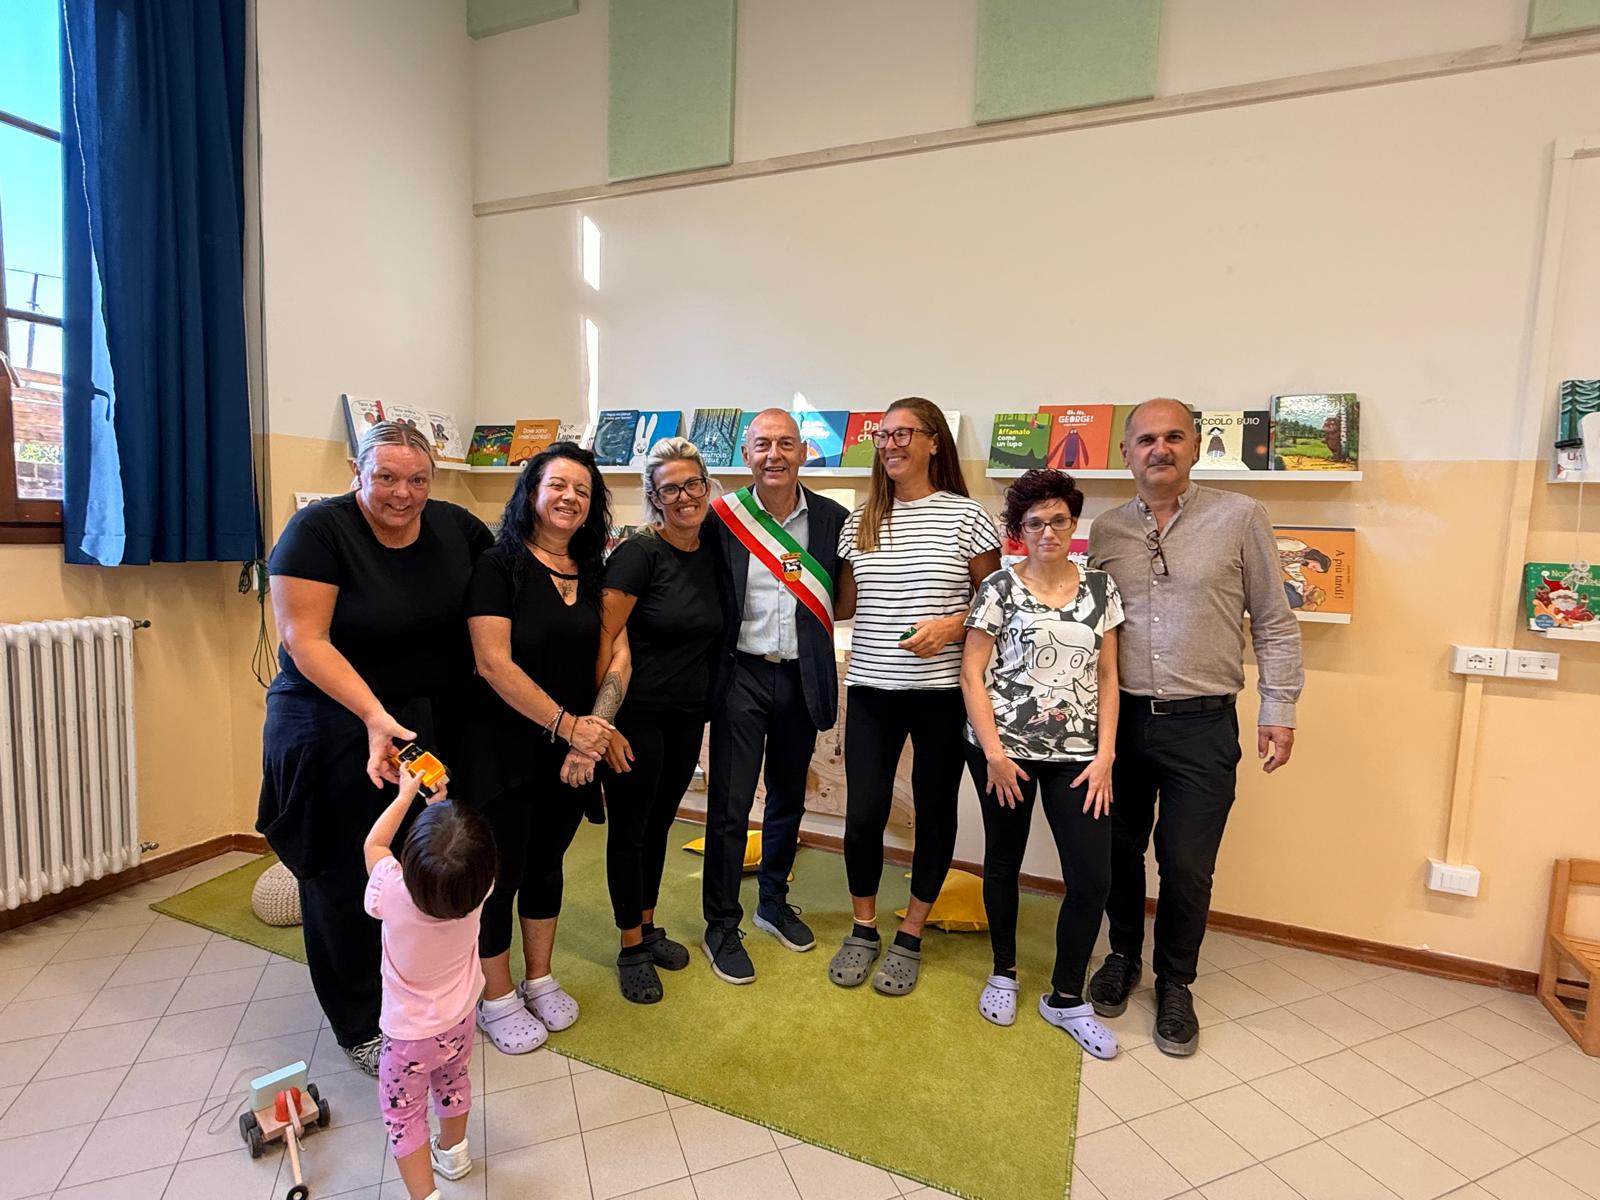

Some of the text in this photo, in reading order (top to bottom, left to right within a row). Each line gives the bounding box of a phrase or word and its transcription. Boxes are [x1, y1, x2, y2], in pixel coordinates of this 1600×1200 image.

[1058, 415, 1094, 423] GEORGE!
[1193, 417, 1260, 426] PICCOLO BUIO
[1006, 440, 1023, 449] lupo
